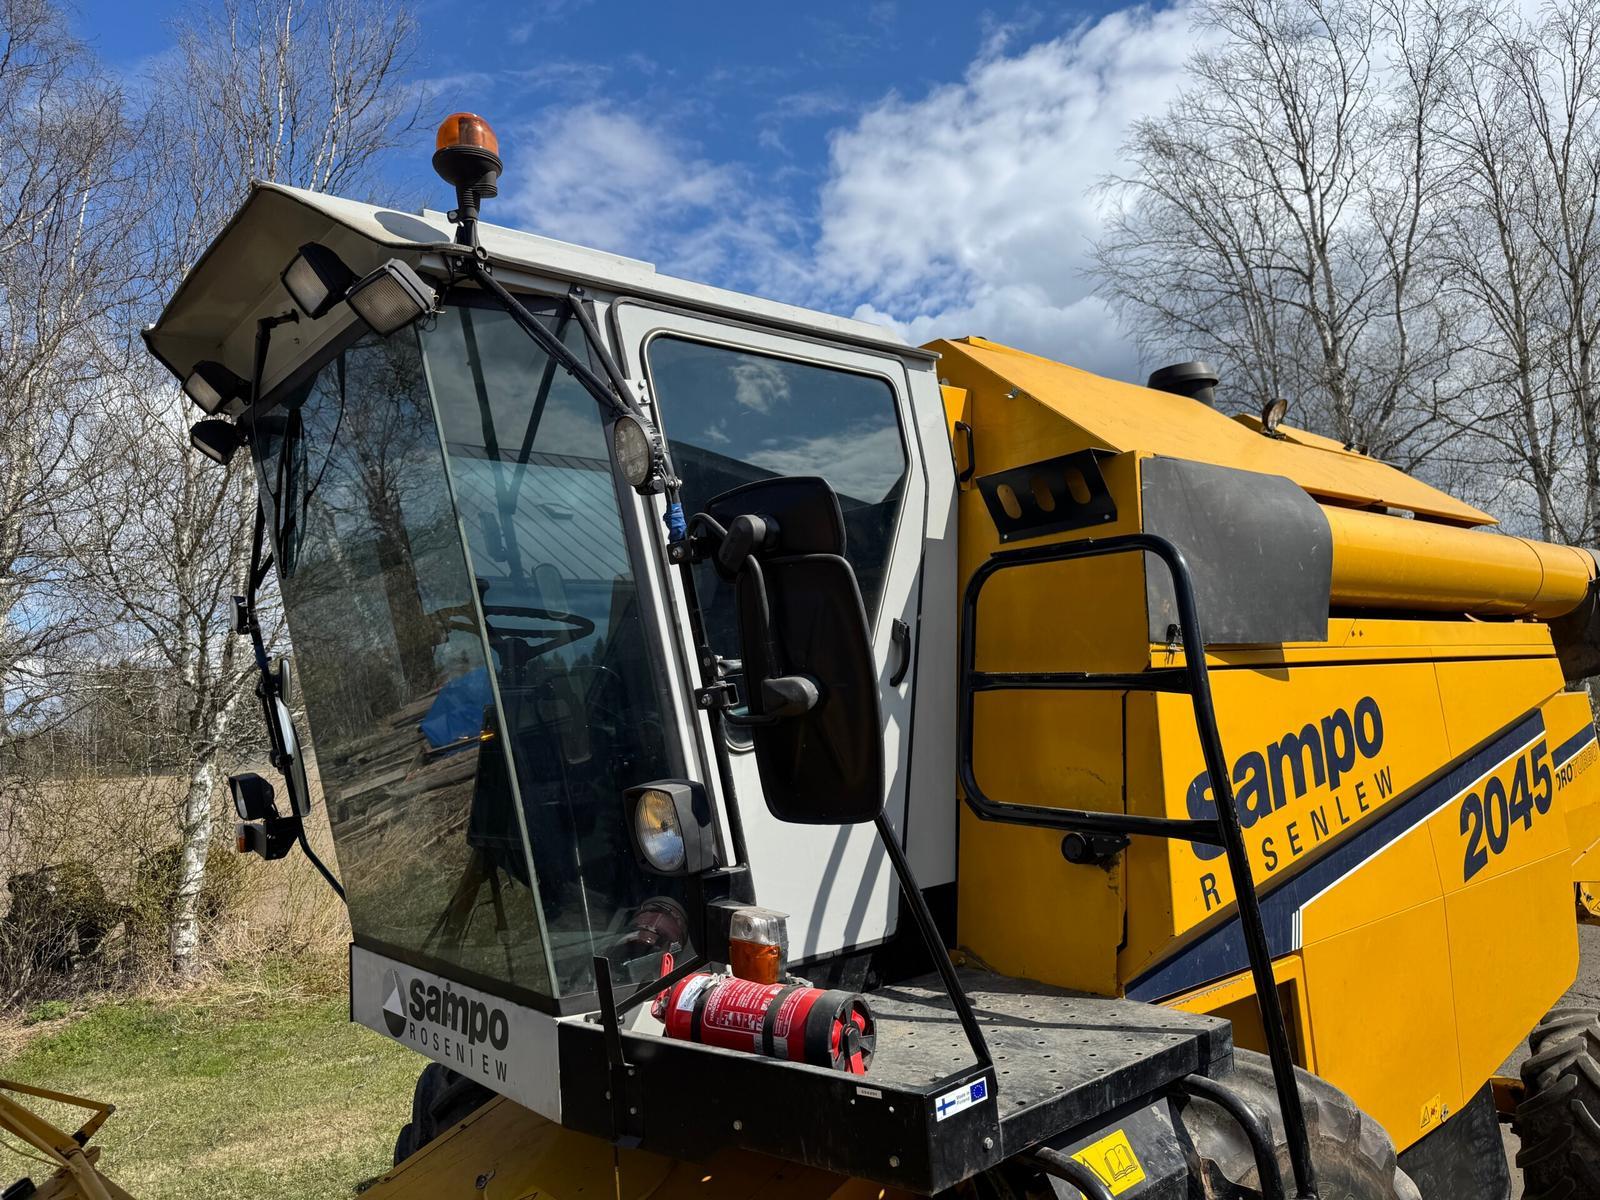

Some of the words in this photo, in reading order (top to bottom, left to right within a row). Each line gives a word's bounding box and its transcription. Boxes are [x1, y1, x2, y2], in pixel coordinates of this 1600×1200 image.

[1200, 765, 1393, 912] RSENLEW
[1459, 738, 1553, 882] 2045
[409, 978, 509, 1051] sampo
